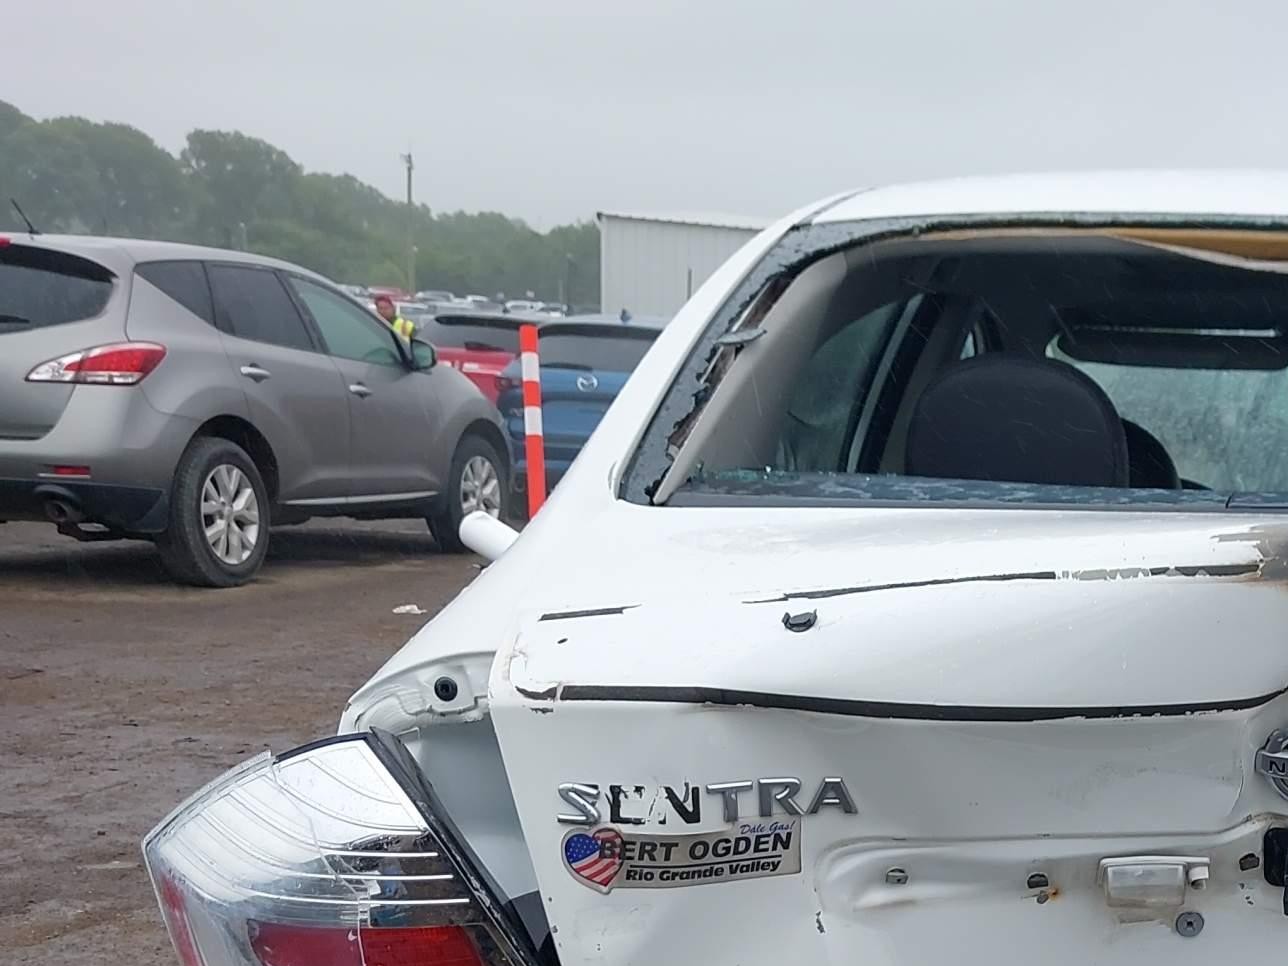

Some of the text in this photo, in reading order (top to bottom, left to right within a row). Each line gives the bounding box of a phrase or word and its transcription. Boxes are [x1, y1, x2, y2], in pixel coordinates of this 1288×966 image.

[599, 832, 792, 862] BERT OGDEN
[625, 859, 781, 881] Rio Grande Valley
